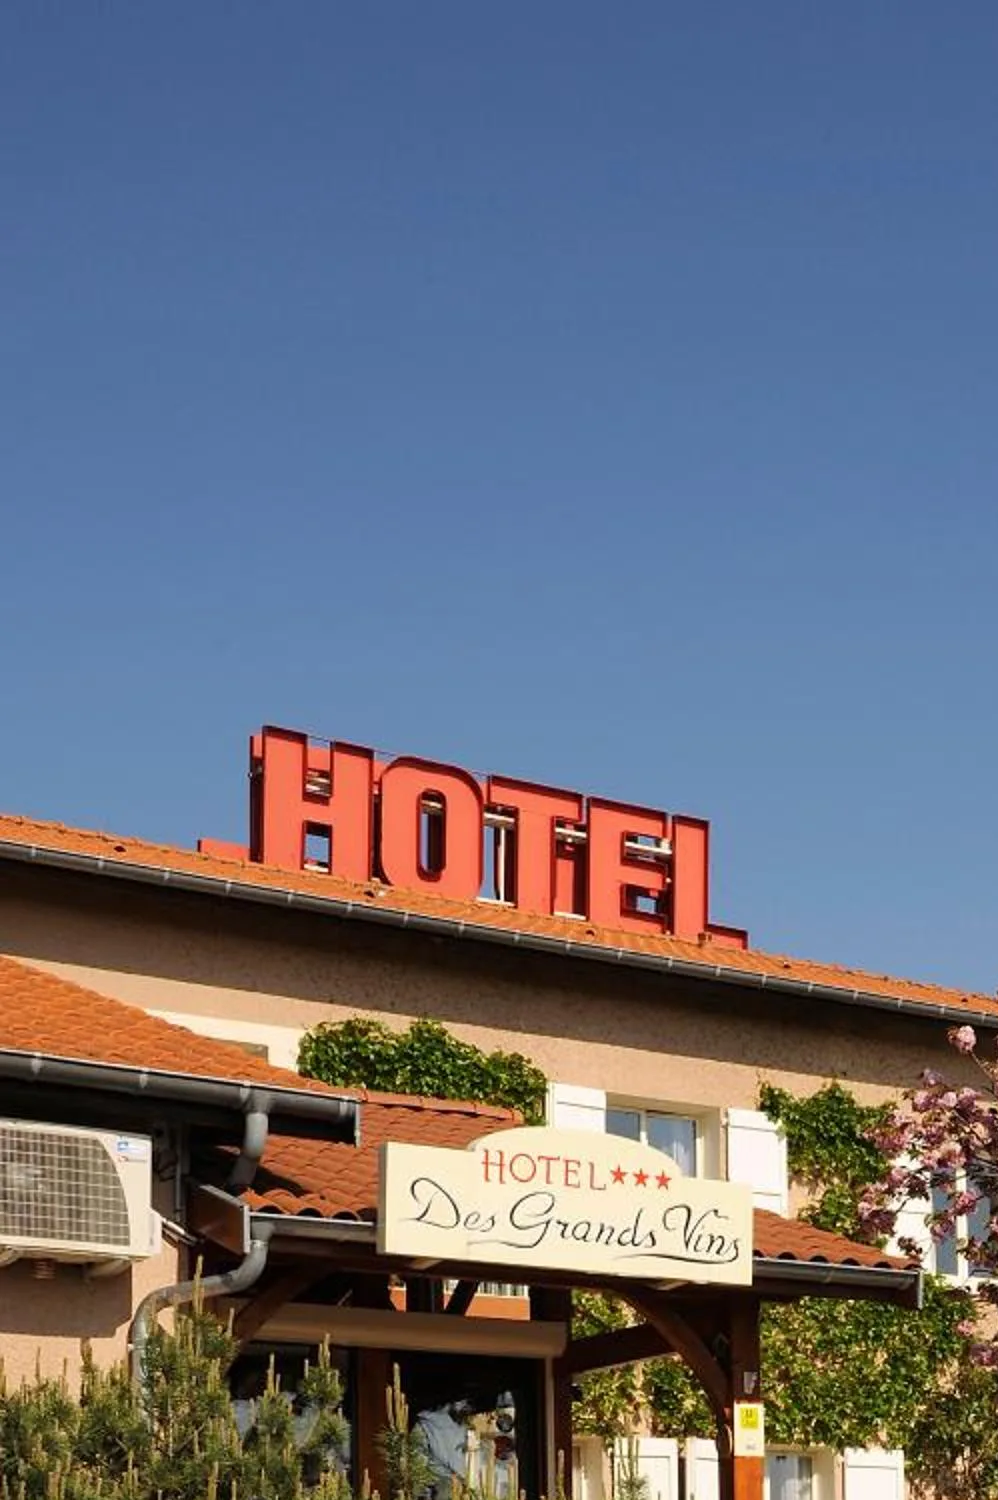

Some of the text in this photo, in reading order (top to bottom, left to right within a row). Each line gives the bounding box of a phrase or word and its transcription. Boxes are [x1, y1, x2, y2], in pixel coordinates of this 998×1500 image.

[252, 725, 748, 949] HOTEL
[481, 1149, 606, 1191] HOTEL
[403, 1177, 741, 1264] Des Grands Vins
